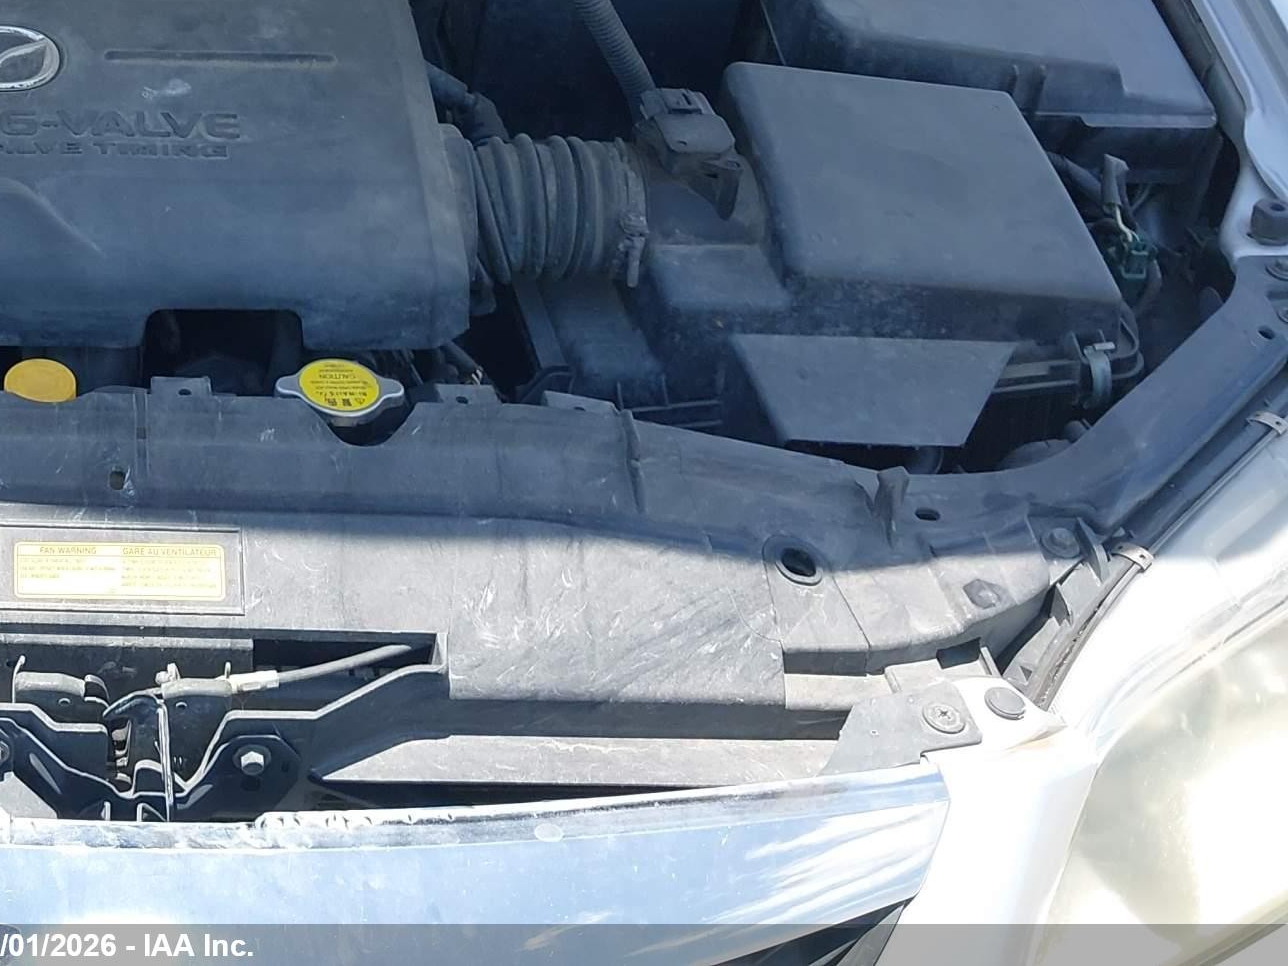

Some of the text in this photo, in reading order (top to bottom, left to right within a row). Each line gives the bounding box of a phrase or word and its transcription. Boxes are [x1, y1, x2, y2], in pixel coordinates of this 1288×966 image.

[93, 142, 228, 158] TIMING
[39, 546, 97, 555] FAN WARNING
[122, 548, 217, 557] GARE AU VENTILATEUR
